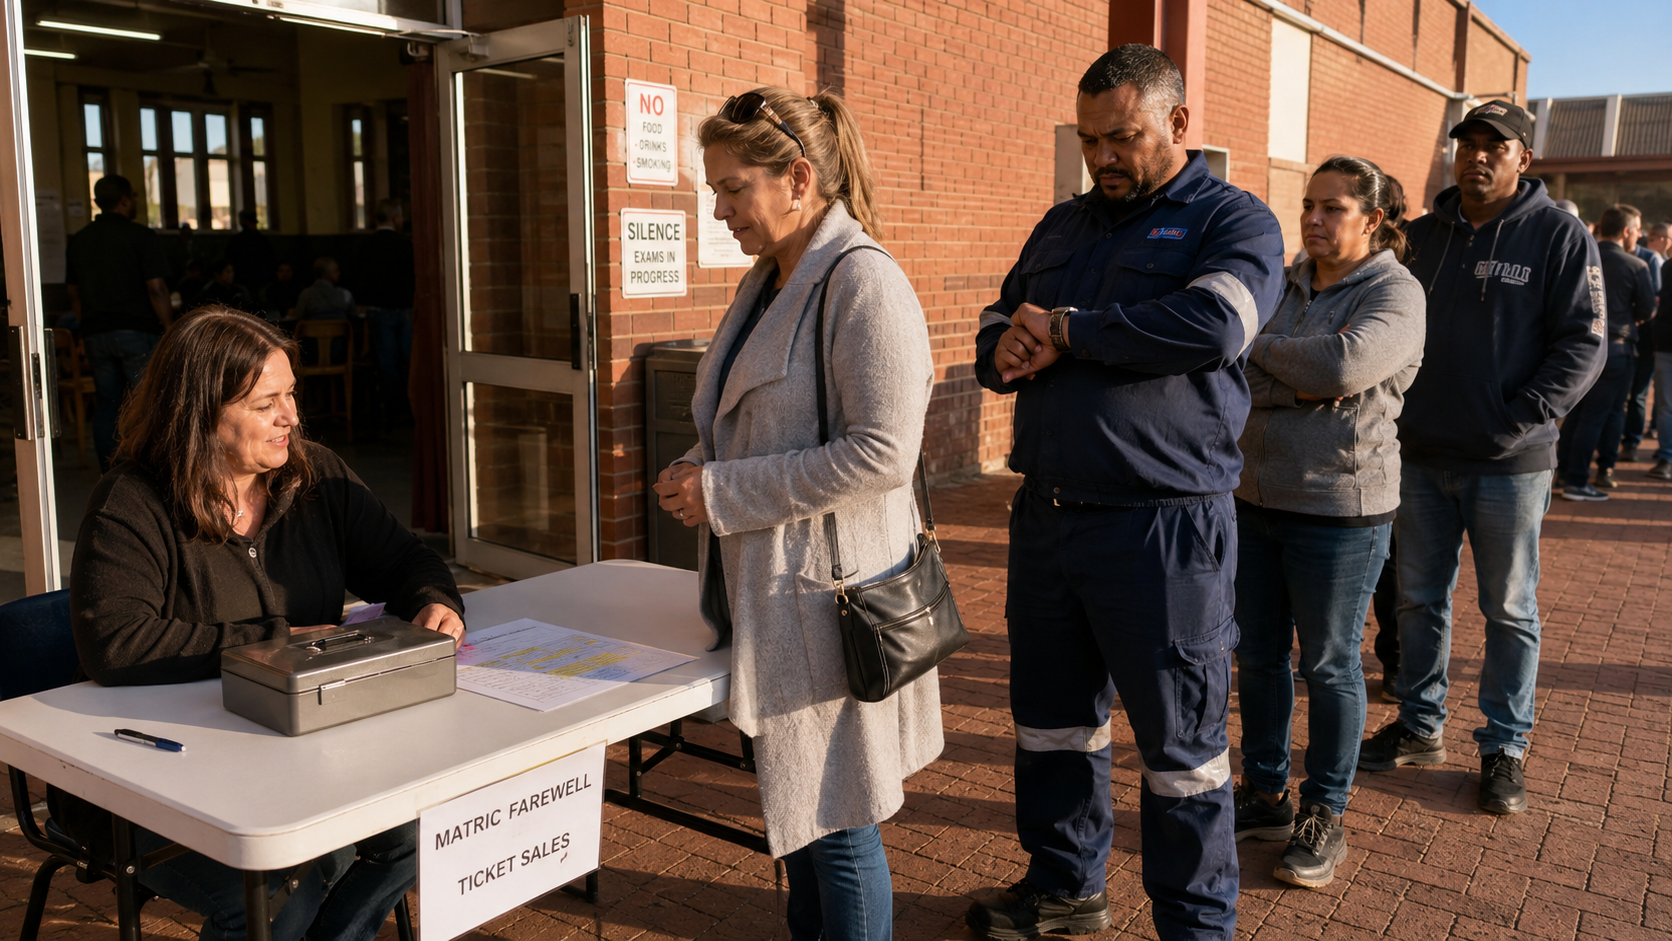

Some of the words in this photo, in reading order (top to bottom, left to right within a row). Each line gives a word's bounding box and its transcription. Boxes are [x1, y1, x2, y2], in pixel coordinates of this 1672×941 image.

[639, 93, 664, 116] NO
[642, 121, 663, 134] FOOD
[628, 221, 681, 241] SILENCE
[634, 250, 664, 263] EXAMS
[666, 250, 676, 263] IN
[630, 270, 680, 284] PROGRESS
[435, 808, 501, 850] MATRIC
[508, 773, 592, 820] FAREWELL
[457, 855, 516, 895] TICKET
[520, 832, 571, 867] SALES
